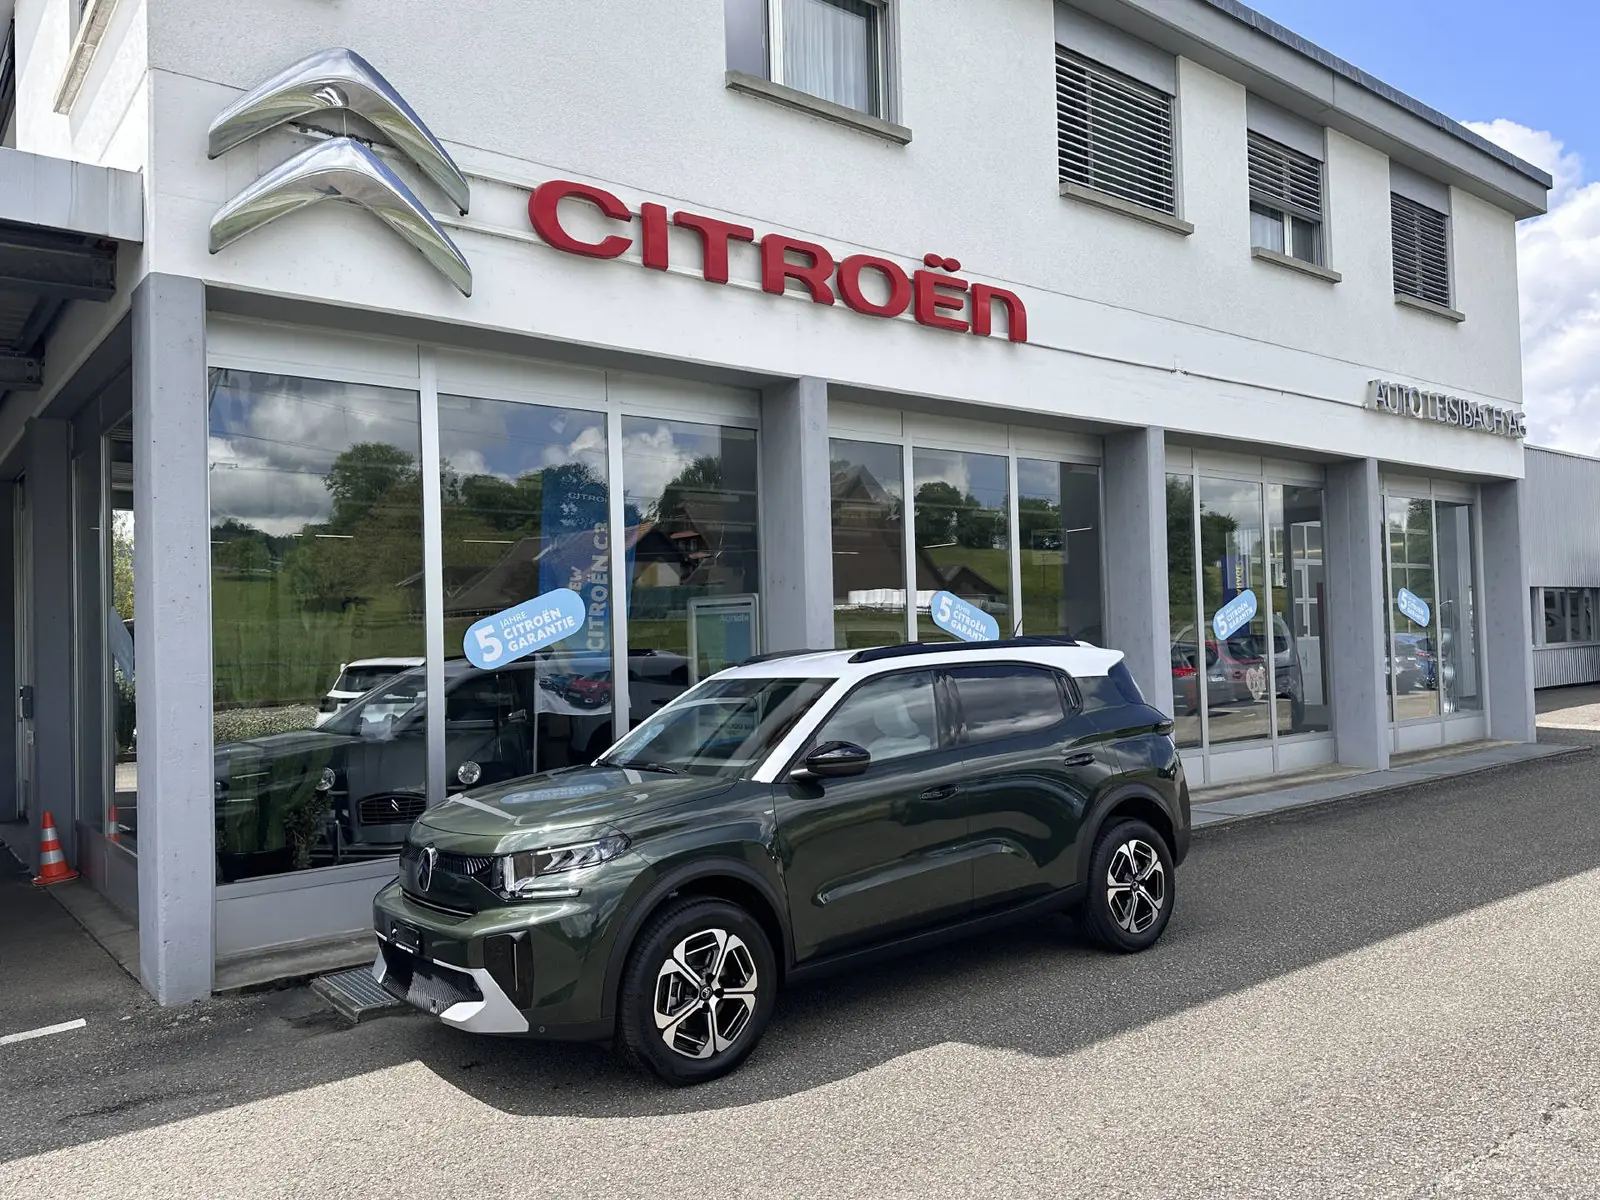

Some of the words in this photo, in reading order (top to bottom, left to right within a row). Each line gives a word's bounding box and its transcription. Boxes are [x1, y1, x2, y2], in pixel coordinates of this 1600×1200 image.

[1372, 379, 1423, 418] AUTO
[1507, 410, 1527, 438] AG
[568, 492, 607, 503] CITRO
[587, 555, 609, 651] CITROËN
[937, 595, 953, 623] 5
[500, 611, 528, 629] JAHRE
[503, 607, 562, 640] CITROËN
[508, 616, 576, 652] GARANTIE
[1216, 612, 1228, 636] 5
[474, 624, 503, 662] 5
